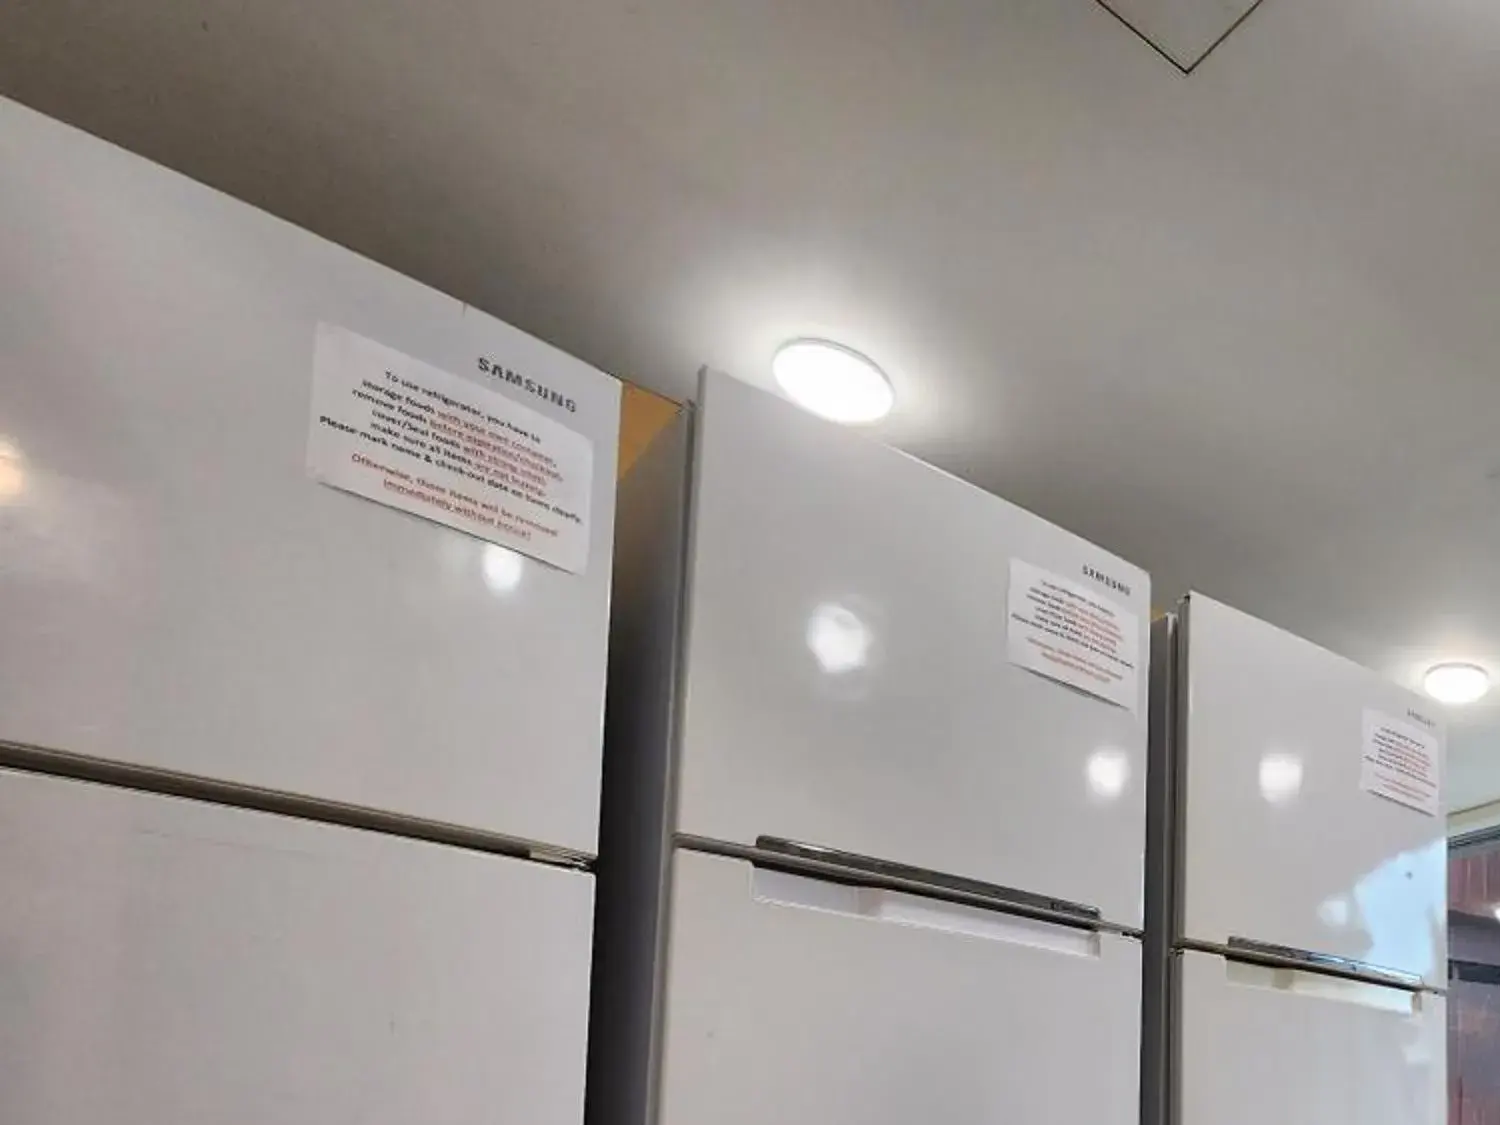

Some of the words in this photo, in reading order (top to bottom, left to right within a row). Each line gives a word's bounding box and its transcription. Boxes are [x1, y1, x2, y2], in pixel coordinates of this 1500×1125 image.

[477, 356, 577, 413] SAMSUNG
[319, 414, 357, 436] Please
[391, 442, 421, 460] name
